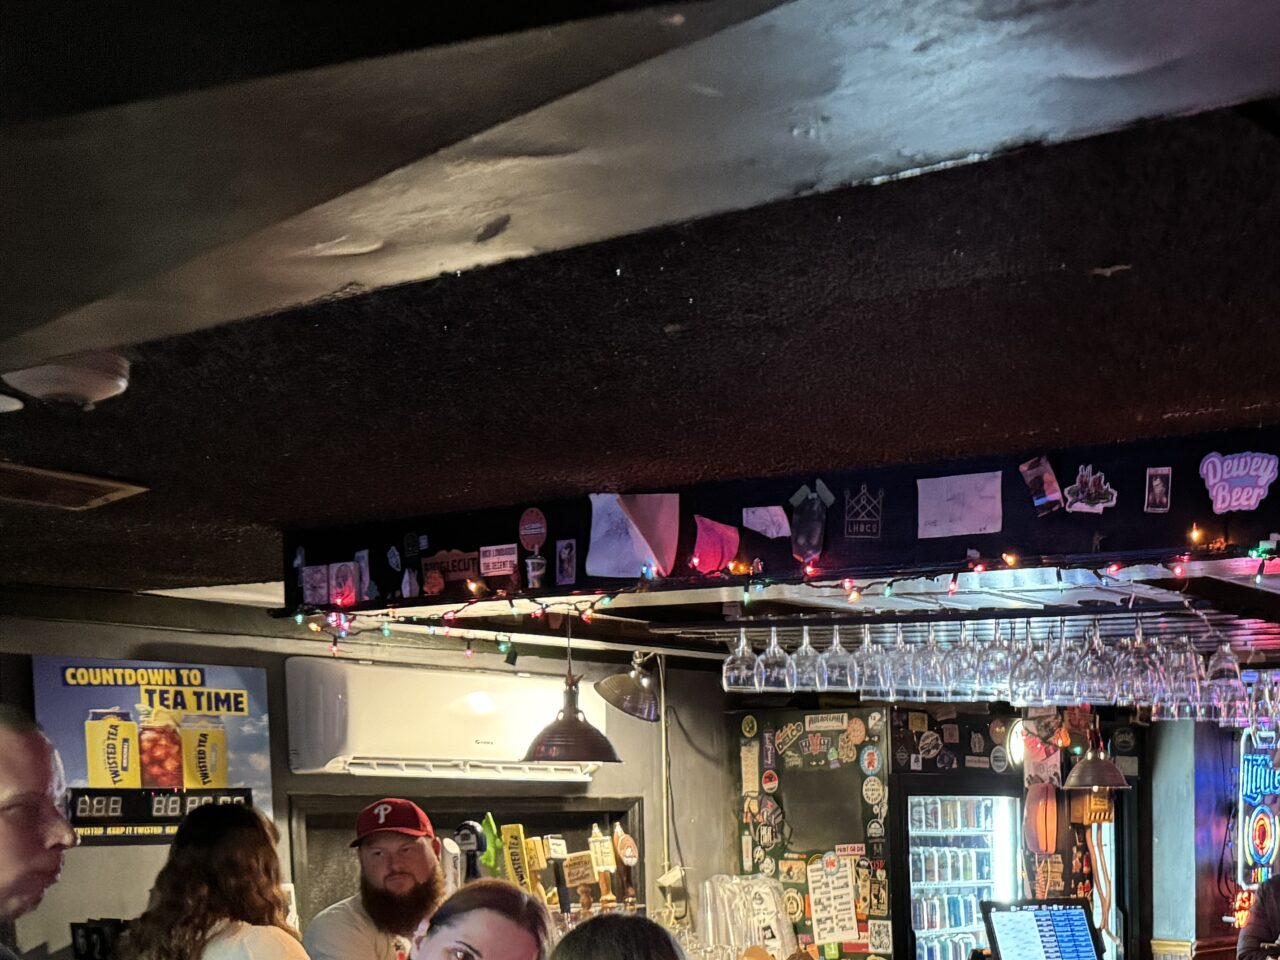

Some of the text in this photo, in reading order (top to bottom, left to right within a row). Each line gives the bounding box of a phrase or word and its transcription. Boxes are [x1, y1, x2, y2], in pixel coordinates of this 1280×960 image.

[1202, 456, 1276, 486] Dewey
[1212, 481, 1265, 509] Beer
[65, 667, 202, 686] COUNTDOWN TO
[145, 689, 245, 712] TEA TIME
[106, 724, 123, 785] TWISTED TEA
[197, 733, 212, 785] TWISTED TEA
[373, 804, 392, 824] P
